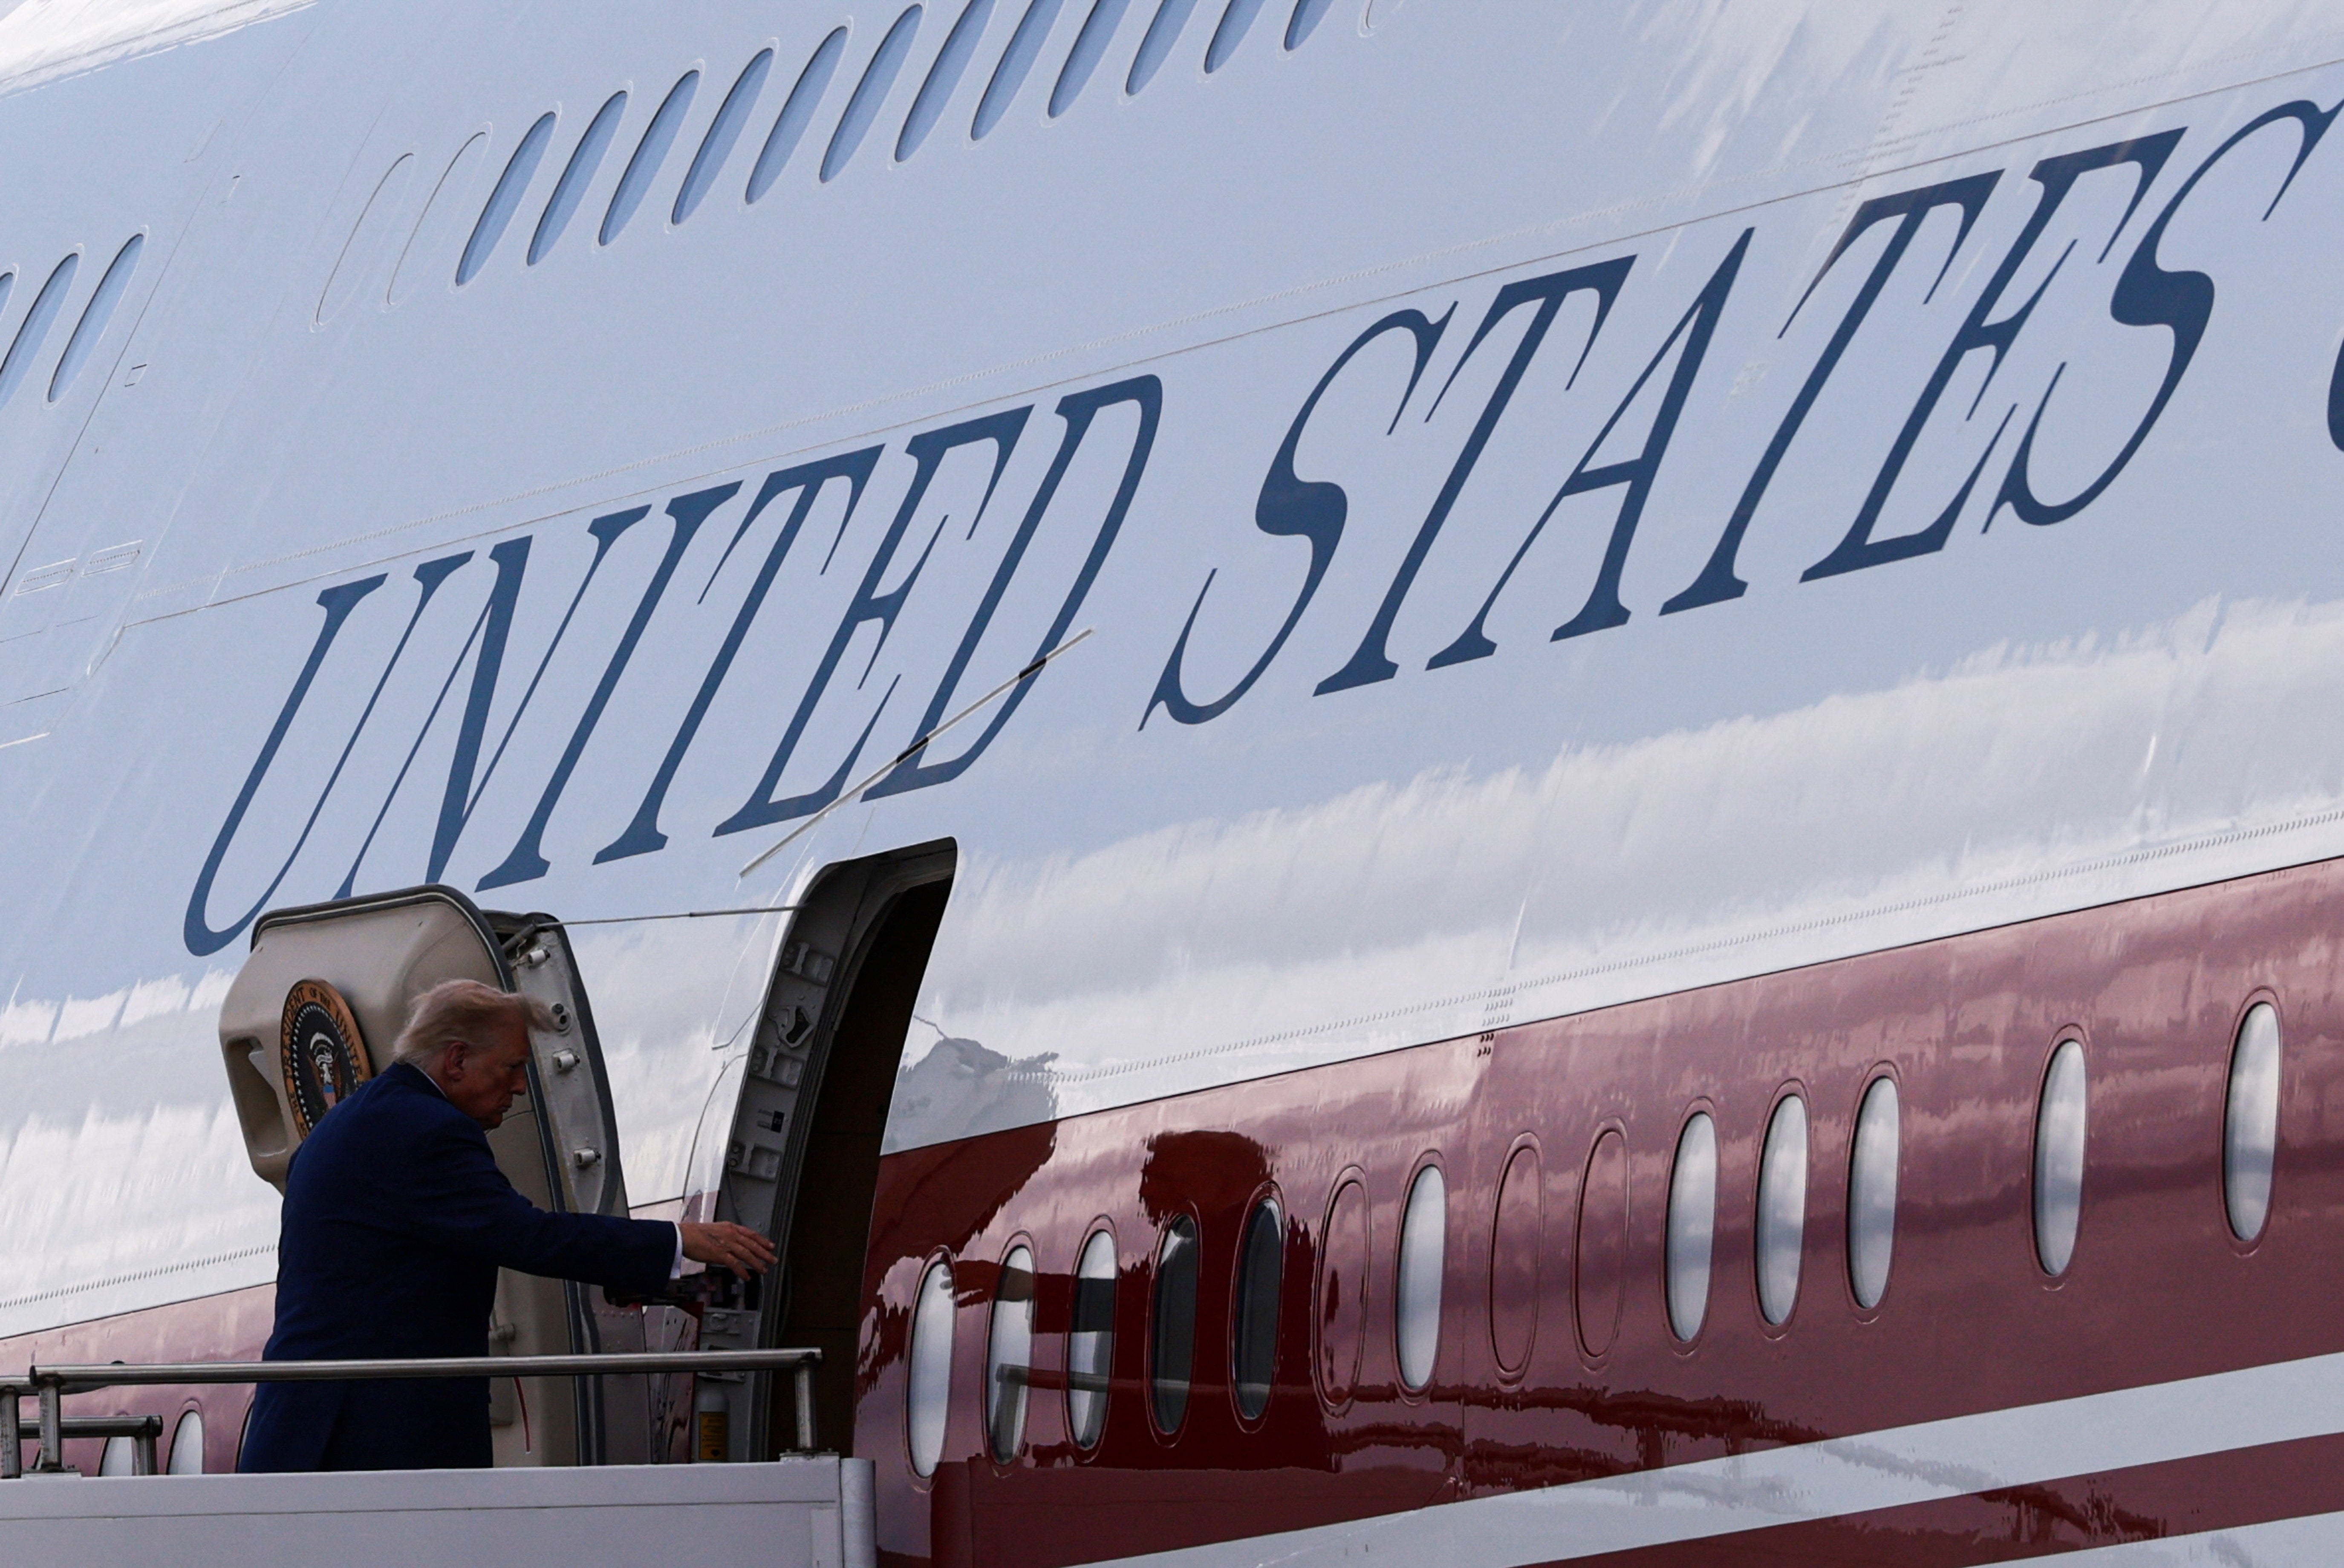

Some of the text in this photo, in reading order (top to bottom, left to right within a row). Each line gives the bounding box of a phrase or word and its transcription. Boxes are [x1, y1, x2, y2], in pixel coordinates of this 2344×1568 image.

[183, 99, 2344, 957] UNITED STATES
[283, 987, 305, 1080] PRESIDENT
[309, 987, 317, 998] OF
[319, 991, 331, 1009] THE
